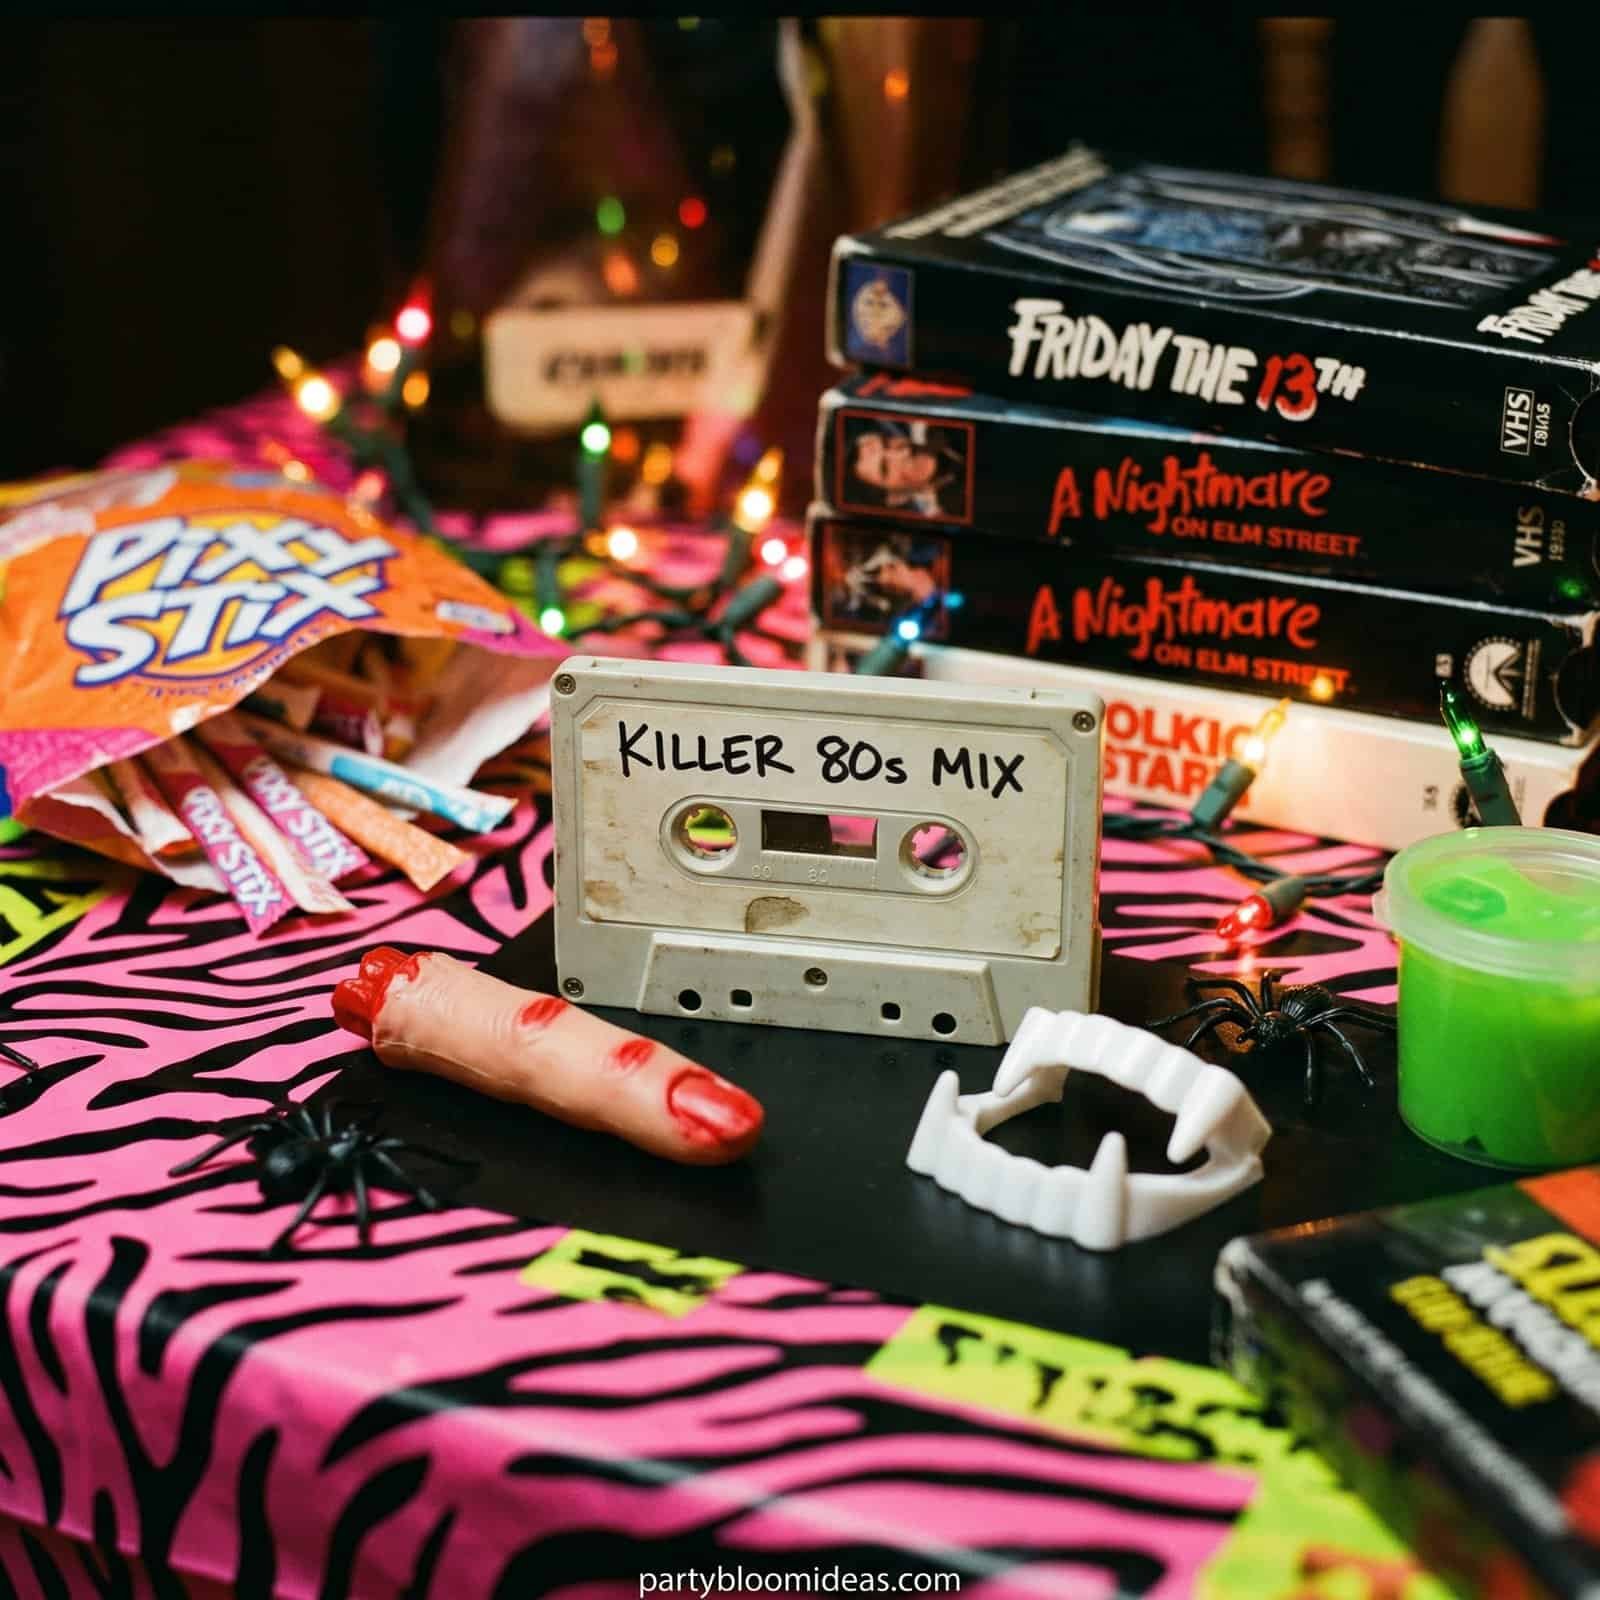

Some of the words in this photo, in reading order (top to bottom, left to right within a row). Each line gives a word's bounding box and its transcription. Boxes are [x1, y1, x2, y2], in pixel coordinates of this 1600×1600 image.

[1008, 298, 1173, 392] FRIDAY
[1170, 334, 1258, 405] THE
[1503, 392, 1533, 449] VHS
[1047, 466, 1083, 537] A
[1093, 451, 1331, 535] Nightmare
[1171, 516, 1208, 542] ON
[1212, 520, 1264, 546] ELM
[1267, 527, 1361, 557] STREET
[1511, 505, 1544, 568] VHS
[1025, 584, 1062, 655] A
[1072, 574, 1321, 661] Nightmare
[1153, 643, 1190, 669] ON
[1195, 648, 1248, 677] ELM
[1252, 657, 1350, 694] STREET
[618, 720, 795, 777] KILLER
[816, 735, 908, 785] 80s
[932, 747, 1025, 799] MIX
